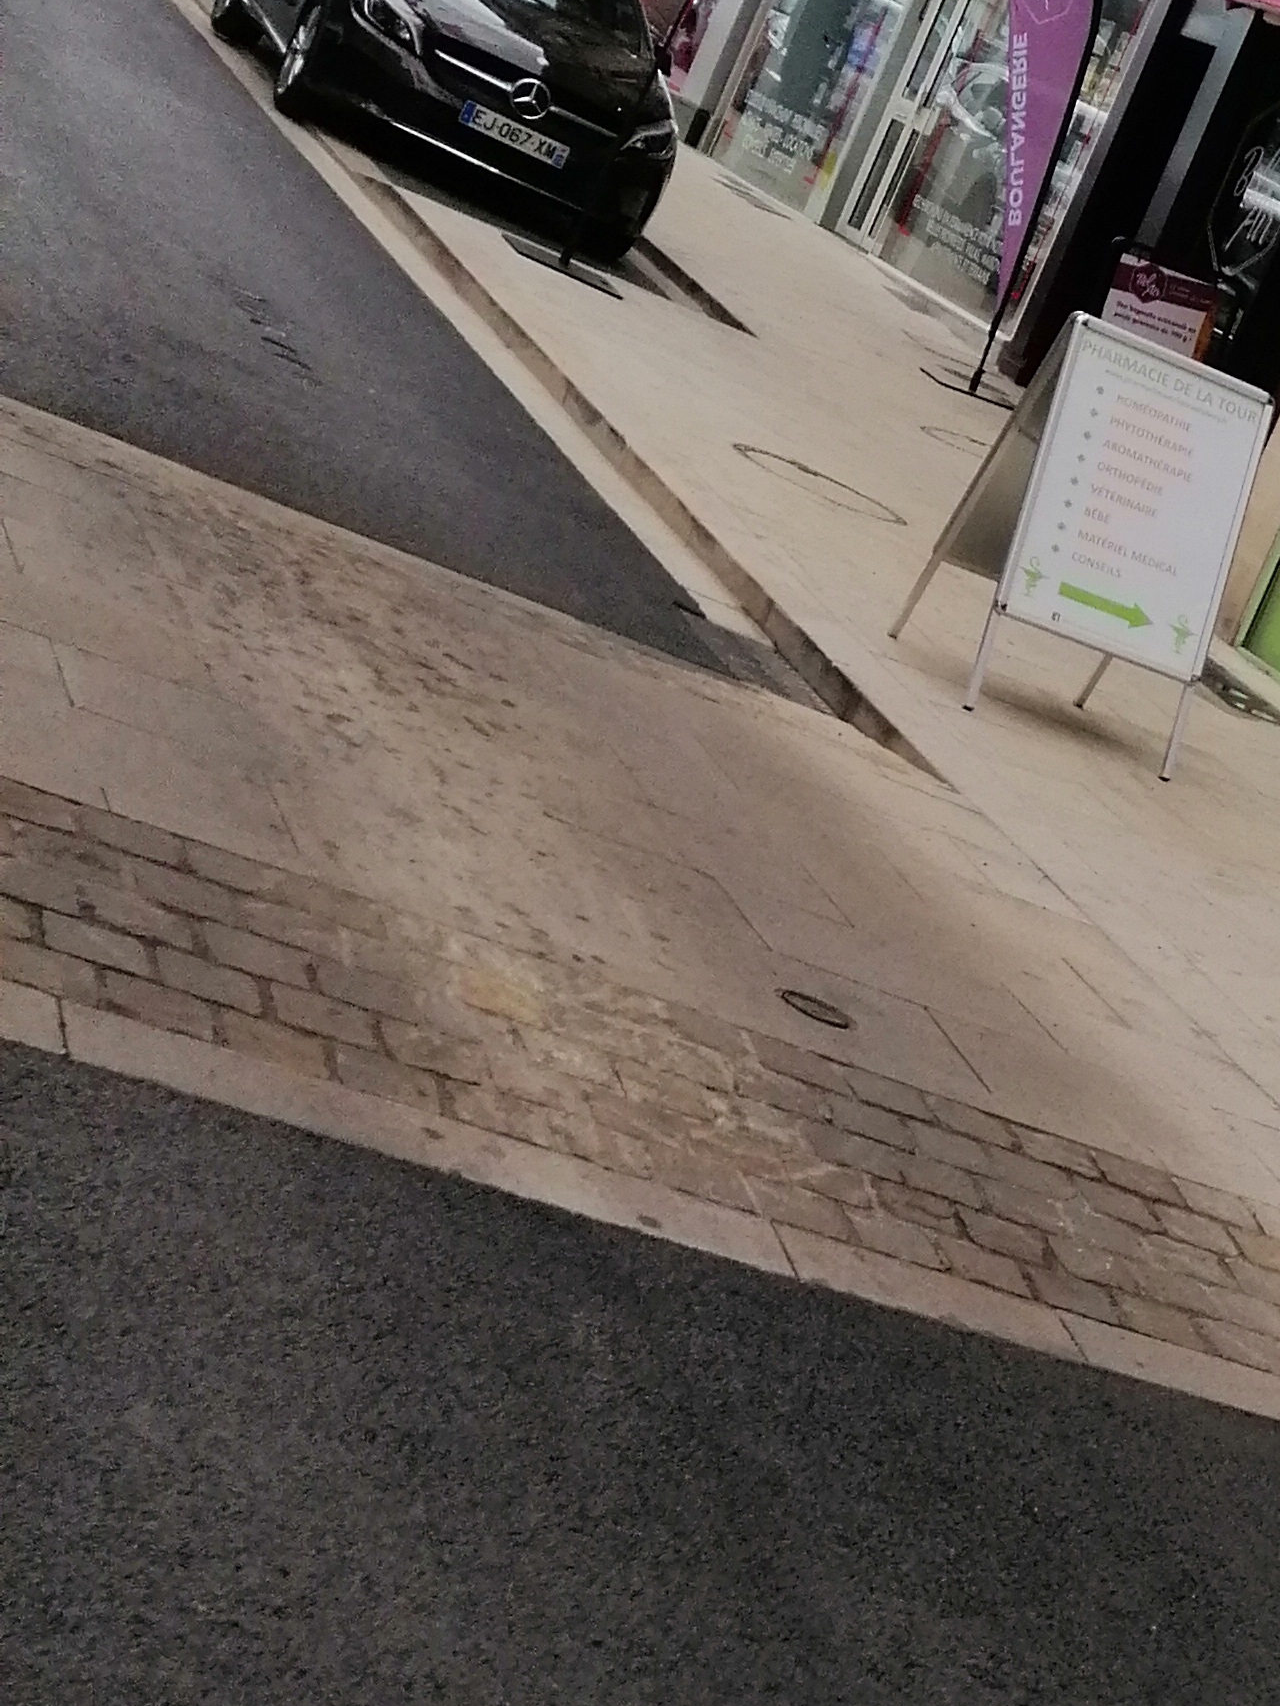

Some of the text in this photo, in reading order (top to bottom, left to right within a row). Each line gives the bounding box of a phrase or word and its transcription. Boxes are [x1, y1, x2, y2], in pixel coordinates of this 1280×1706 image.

[1081, 339, 1170, 386] PHARMACIE
[1173, 380, 1193, 396] DE
[1196, 389, 1213, 407] LA
[1219, 394, 1258, 423] TOUR
[1071, 551, 1122, 579] CONSEILS
